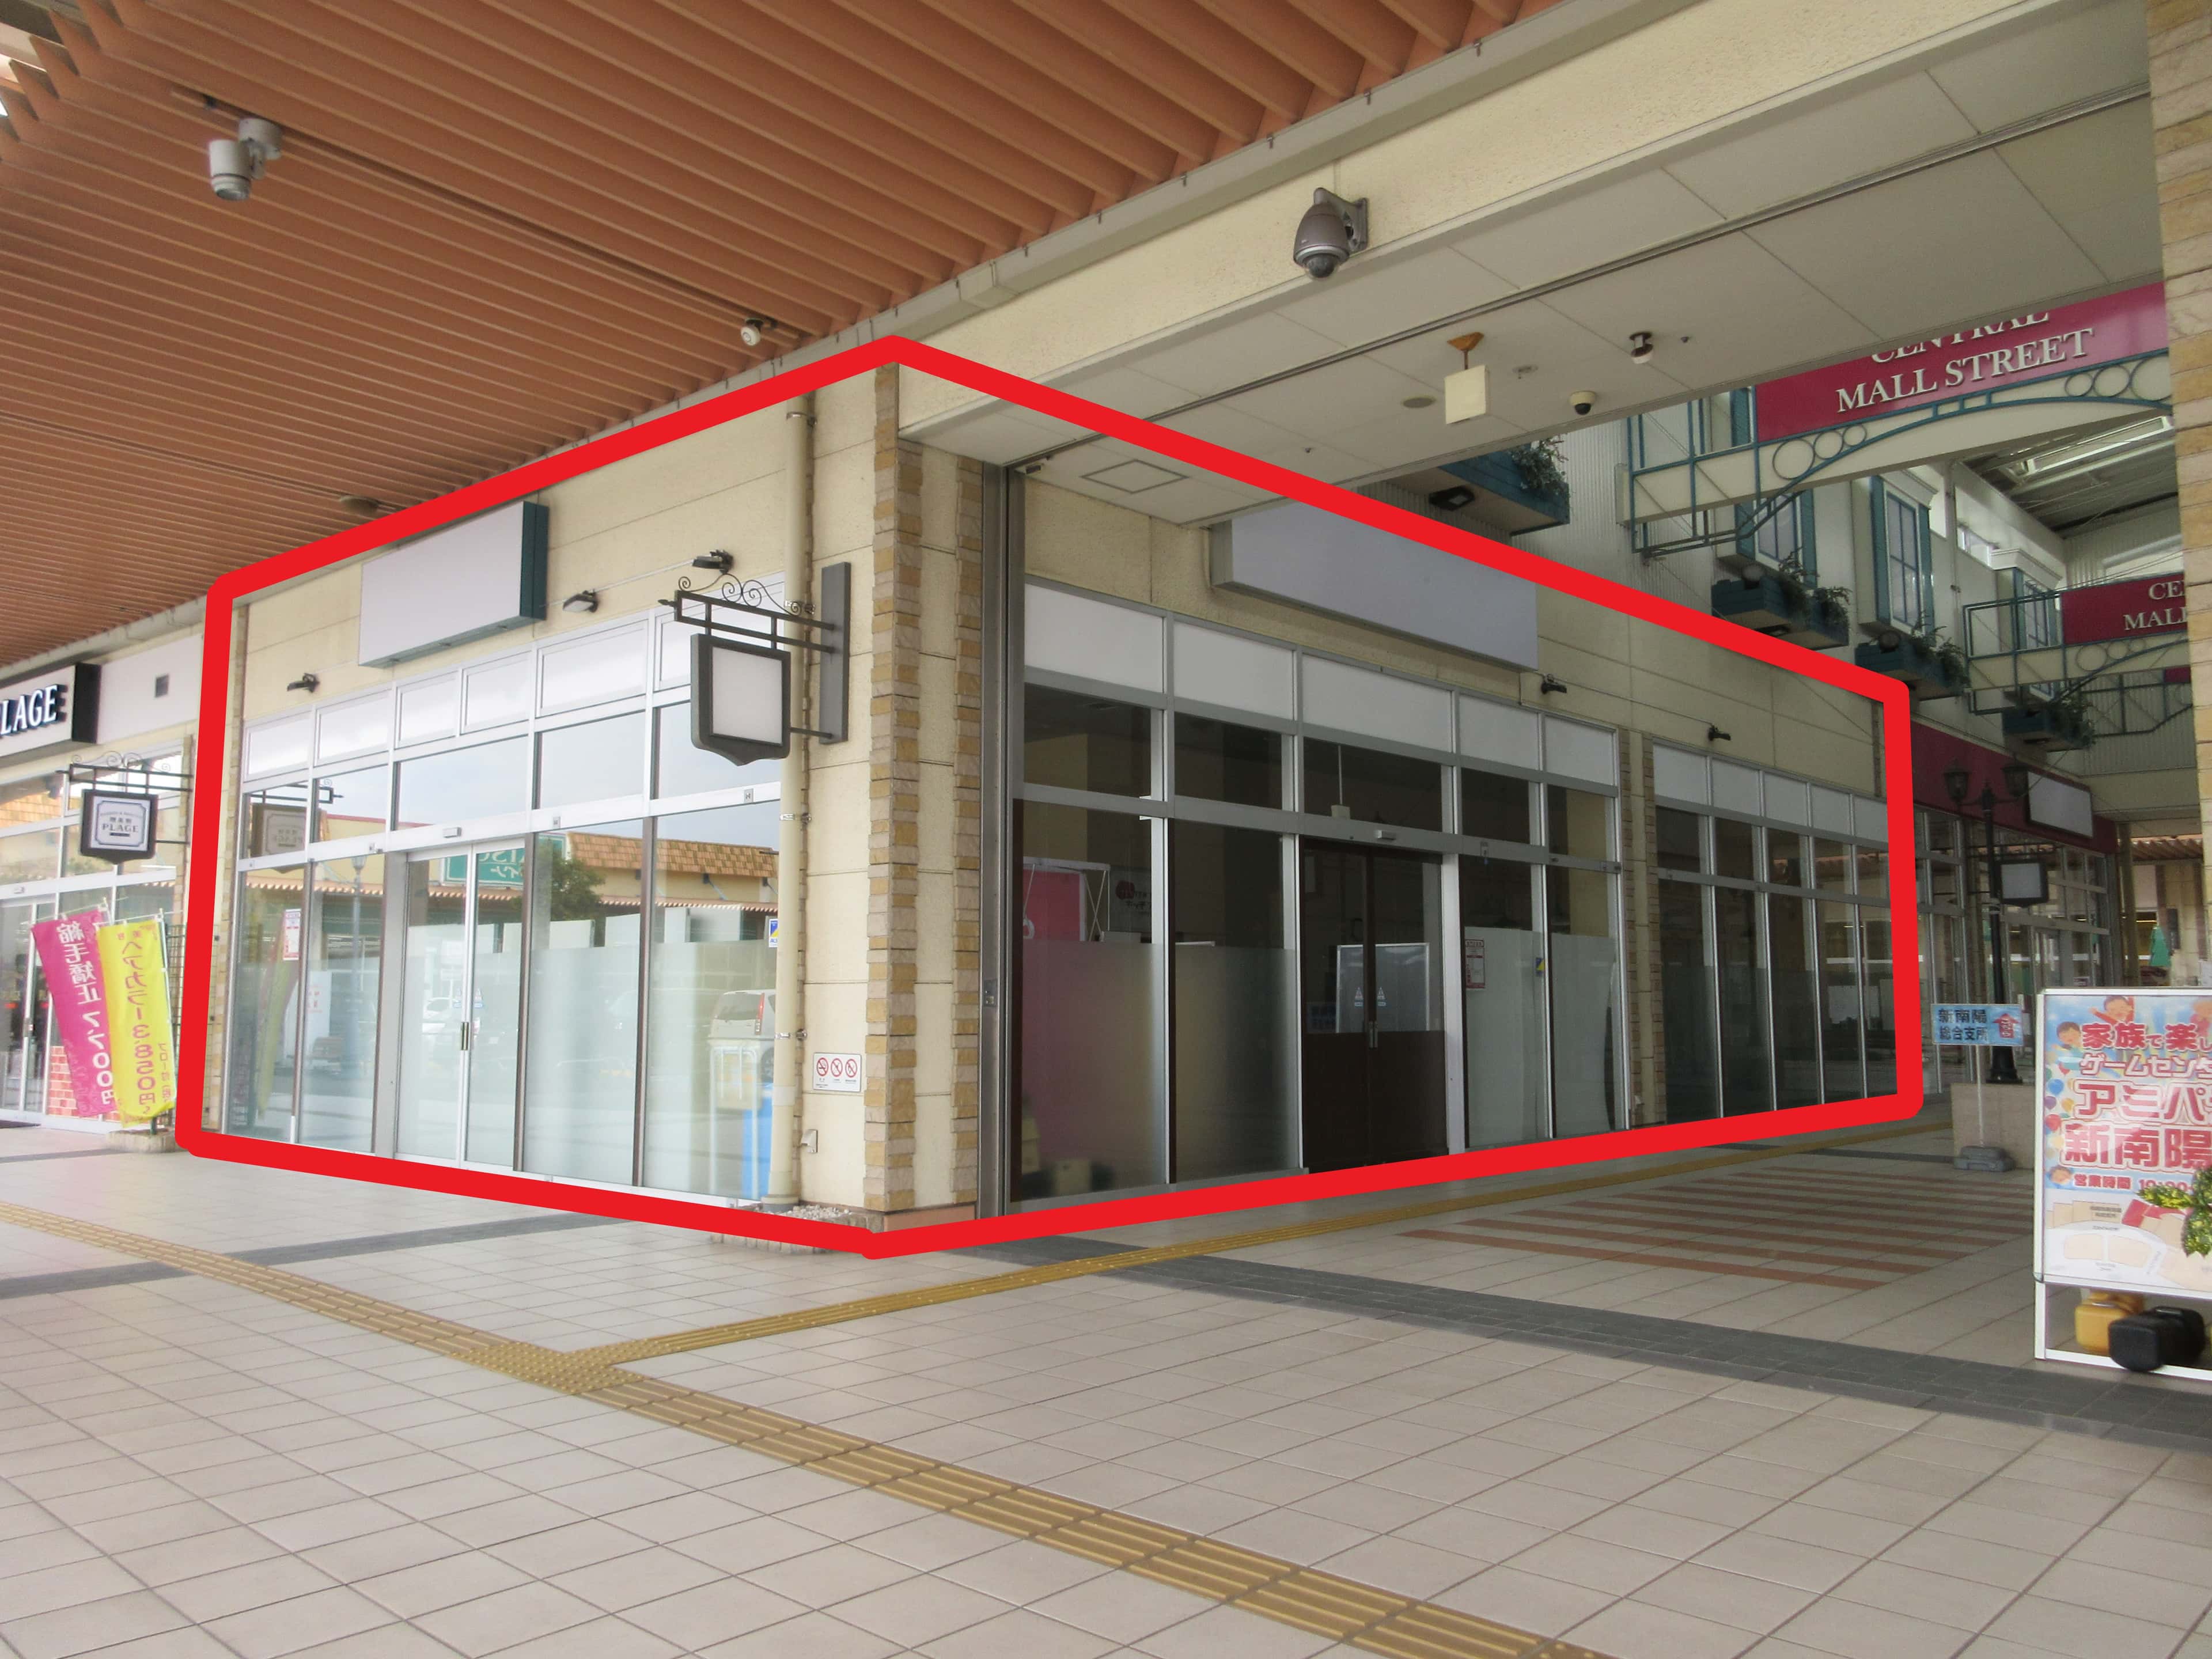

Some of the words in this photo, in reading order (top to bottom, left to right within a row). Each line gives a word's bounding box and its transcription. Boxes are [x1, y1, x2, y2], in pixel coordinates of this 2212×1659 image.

[1836, 368, 1938, 413] MALL
[1945, 327, 2094, 387] STREET
[1938, 1008, 1987, 1024] 新南陽
[1940, 1025, 1988, 1040] 総合支所
[2075, 1081, 2212, 1123] アミパ
[2063, 1123, 2212, 1171] 新南陽
[2074, 1173, 2131, 1190] 営業時間
